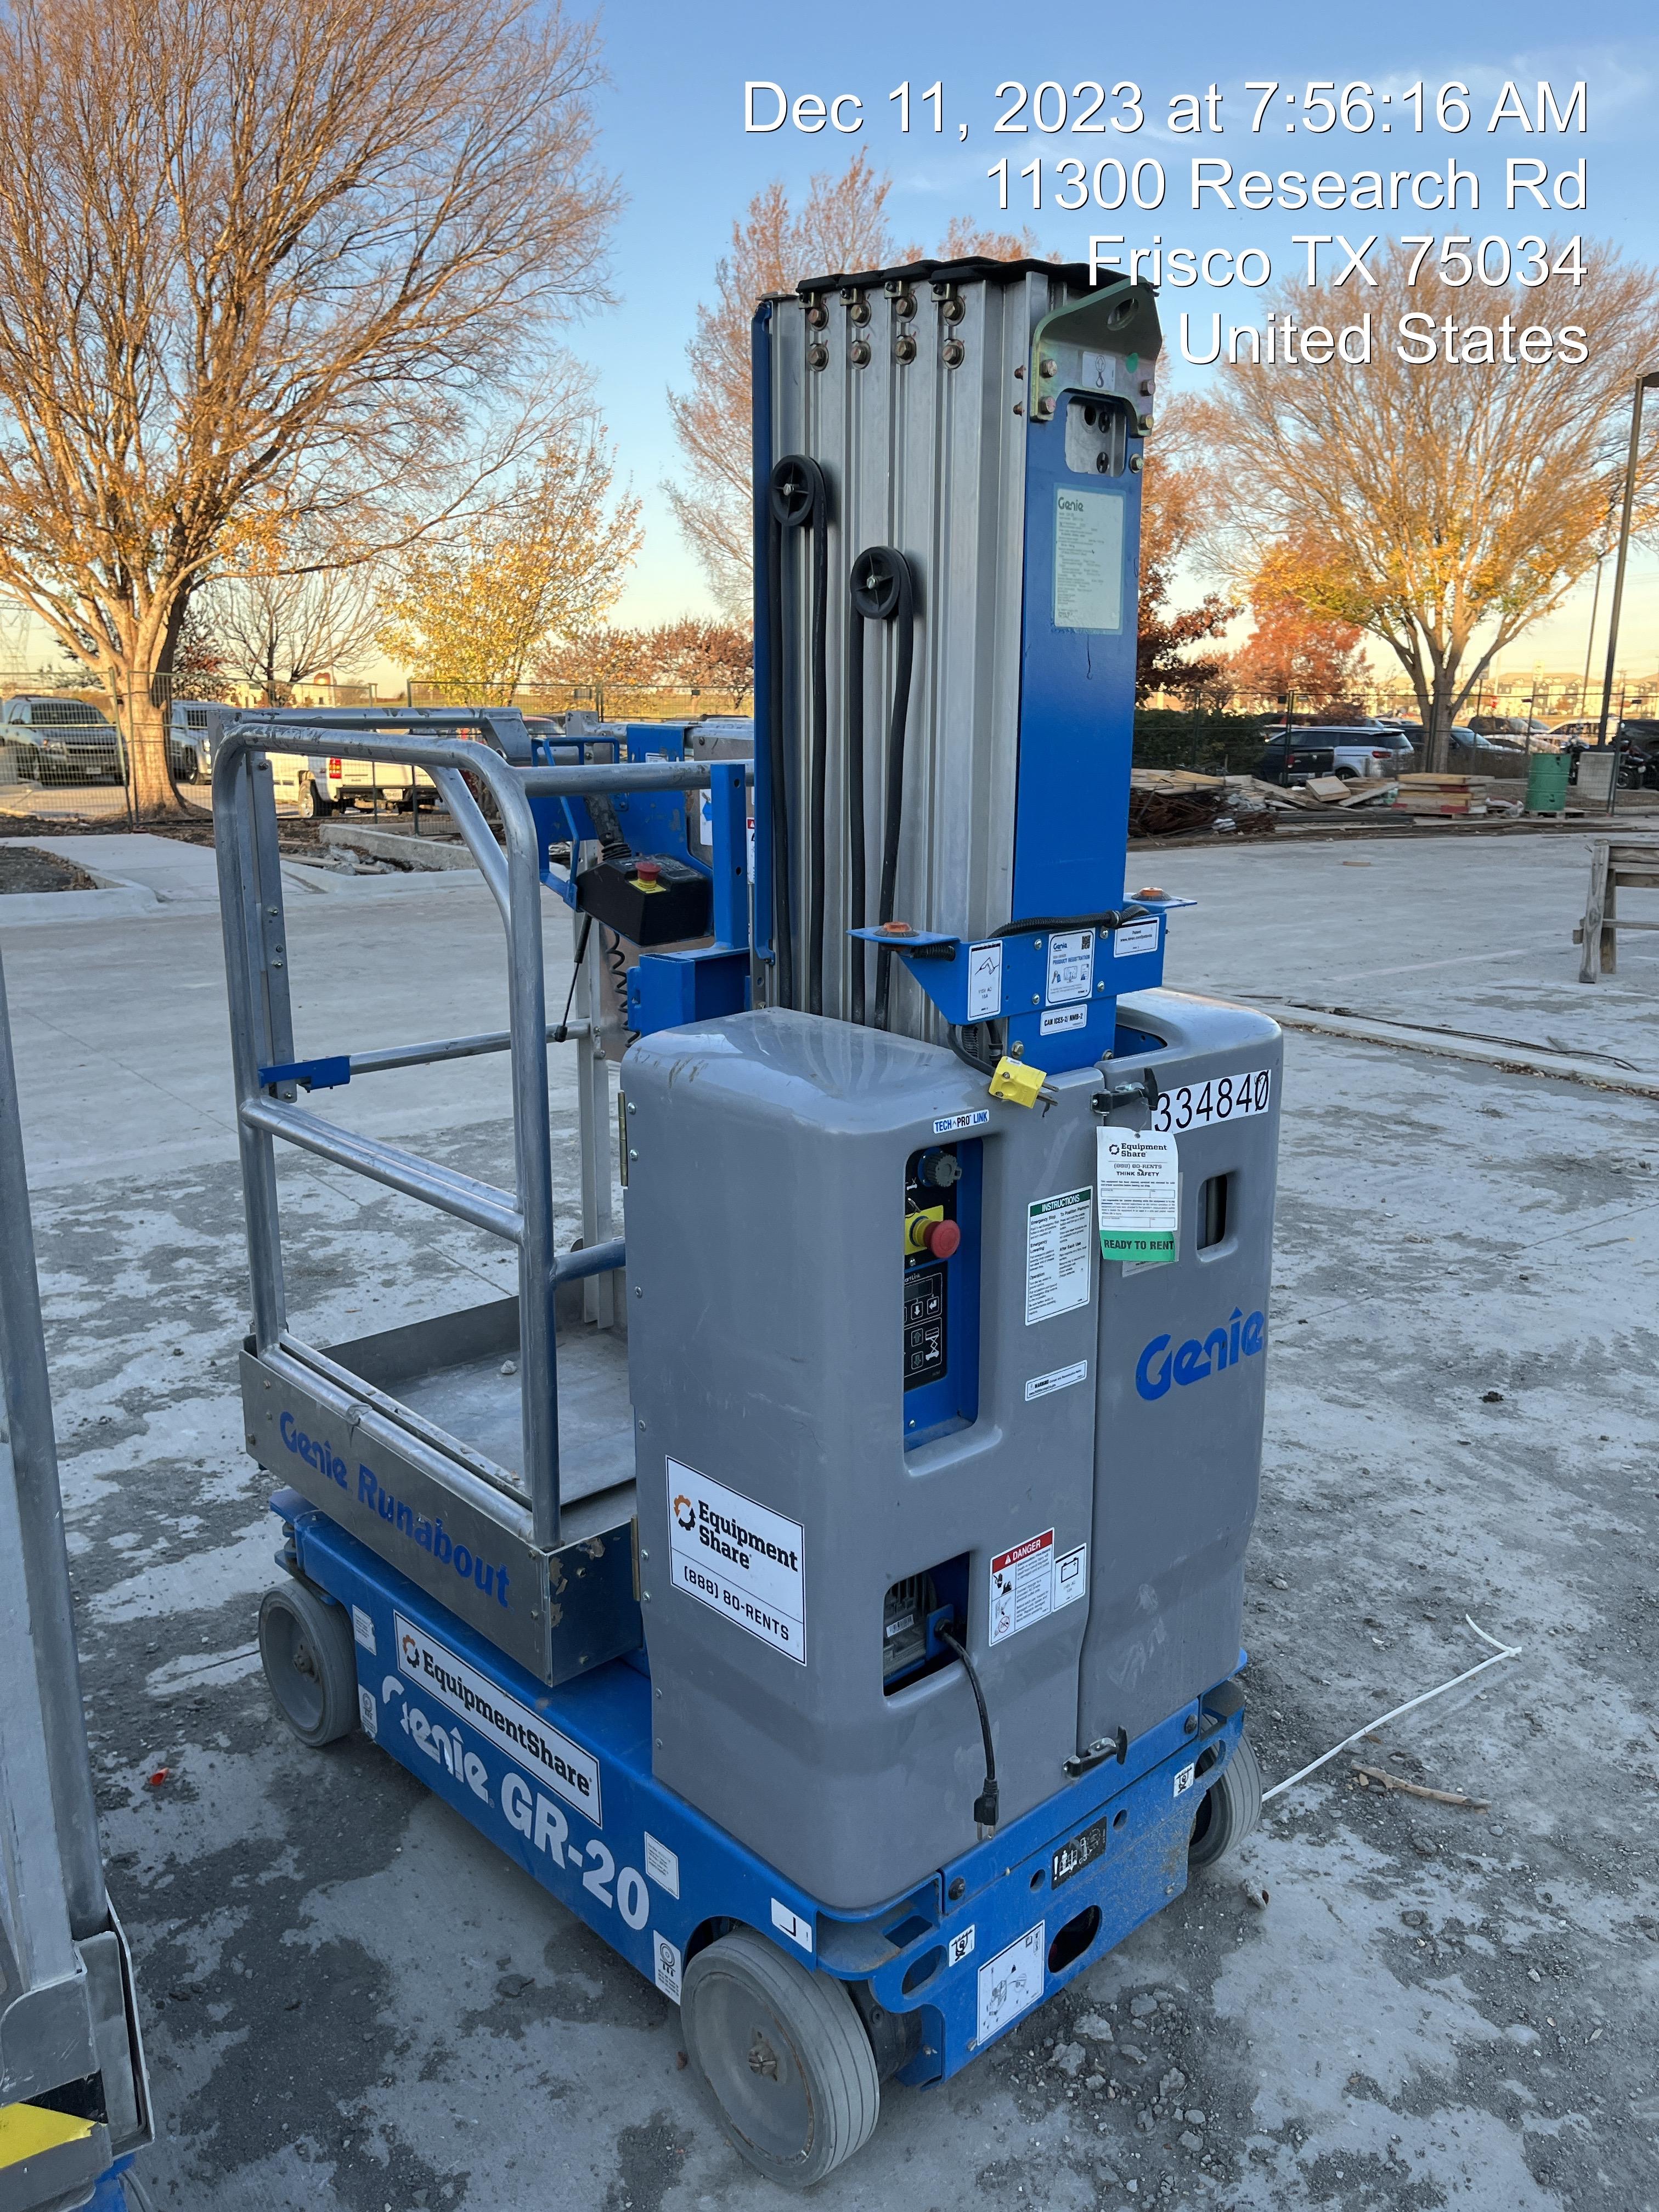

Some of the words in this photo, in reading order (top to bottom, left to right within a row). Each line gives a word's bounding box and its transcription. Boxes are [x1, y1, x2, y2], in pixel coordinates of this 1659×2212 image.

[1058, 496, 1084, 512] Genie
[1044, 1018, 1053, 1026] CAN
[934, 1119, 952, 1132] TECH
[973, 1111, 988, 1124] LINK
[1154, 1070, 1269, 1132] 334840
[1121, 1143, 1167, 1151] Equipment
[1042, 1194, 1080, 1212] INSTRUCTIONS
[1104, 1239, 1132, 1250] READY
[1134, 1240, 1147, 1250] TO
[1150, 1240, 1174, 1250] RENT
[1135, 1306, 1265, 1401] Genie
[279, 1410, 350, 1491] Genie
[357, 1462, 511, 1609] Runabout
[698, 1499, 799, 1572] Equipment
[698, 1524, 751, 1570] Share
[1013, 1538, 1041, 1561] DANGER
[684, 1565, 719, 1599] (888)
[723, 1589, 789, 1641] 80-RENTS
[421, 1649, 590, 1797] EquipmentShare
[501, 1771, 650, 1931] GR-20
